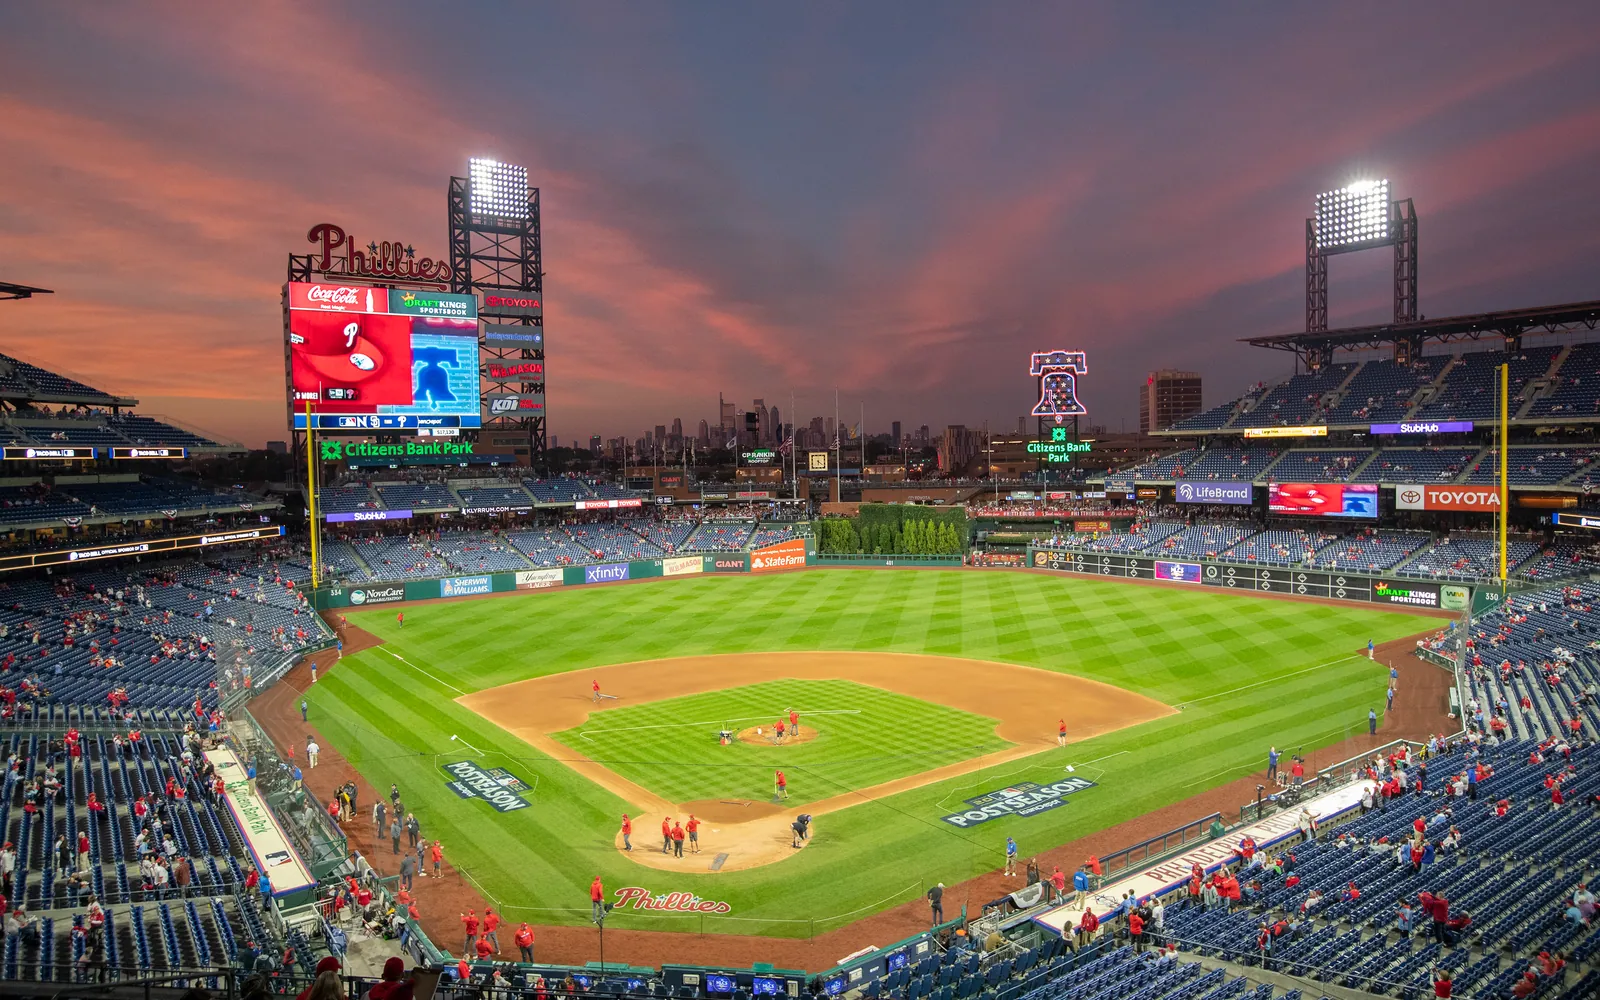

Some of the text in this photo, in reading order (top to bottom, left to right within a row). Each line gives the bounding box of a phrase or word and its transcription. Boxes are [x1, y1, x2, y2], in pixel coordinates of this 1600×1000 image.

[307, 223, 453, 281] Phillies
[404, 299, 467, 309] DRAFTKINGS
[501, 296, 540, 308] TOYOTA
[419, 307, 467, 315] SPORTSBOOK
[1400, 424, 1438, 433] StubHub
[345, 440, 473, 456] Citizens Bank Park
[1027, 442, 1091, 453] Citizens Bank
[1048, 453, 1070, 462] Park
[1196, 487, 1248, 499] LifeBrand
[1428, 491, 1501, 505] TOYOTA
[466, 506, 510, 514] KLYRRUM.COM
[354, 512, 387, 521] StubHub
[715, 560, 744, 568] GIANT
[588, 565, 627, 581] xfinity
[454, 577, 488, 587] SHERWIN
[366, 588, 404, 599] NovaCare
[1377, 588, 1436, 600] DRAFTKINGS
[1485, 592, 1499, 600] 330
[1390, 595, 1436, 605] SPORTSBOOK
[447, 761, 526, 811] POSTSEASON
[947, 778, 1093, 826] POSTSEASON
[250, 820, 272, 834] Park
[613, 887, 731, 913] Phillies
